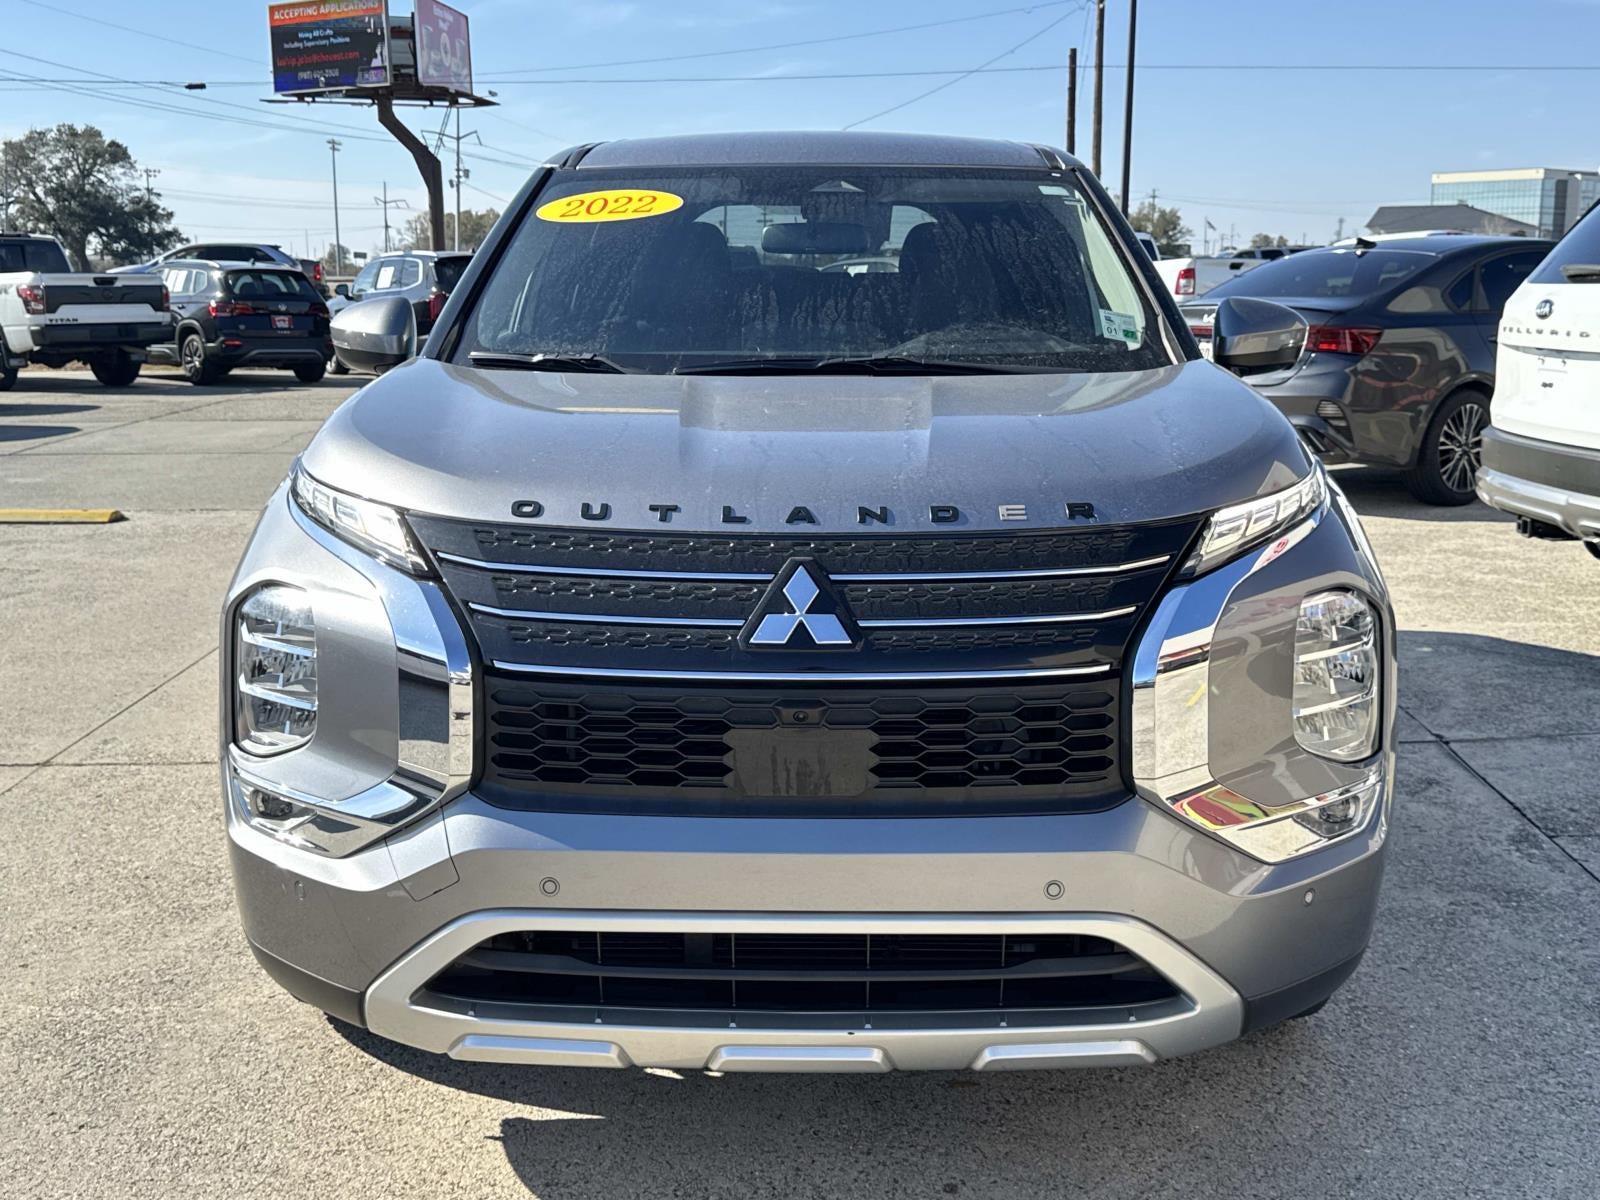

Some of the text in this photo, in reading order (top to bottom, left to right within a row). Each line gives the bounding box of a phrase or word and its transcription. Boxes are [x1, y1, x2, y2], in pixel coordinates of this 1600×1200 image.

[273, 0, 379, 20] ACCEPTING APPLICATIONS
[559, 195, 658, 218] 2022
[1503, 326, 1600, 338] TELLURID
[511, 500, 1099, 524] OUTLANDER
